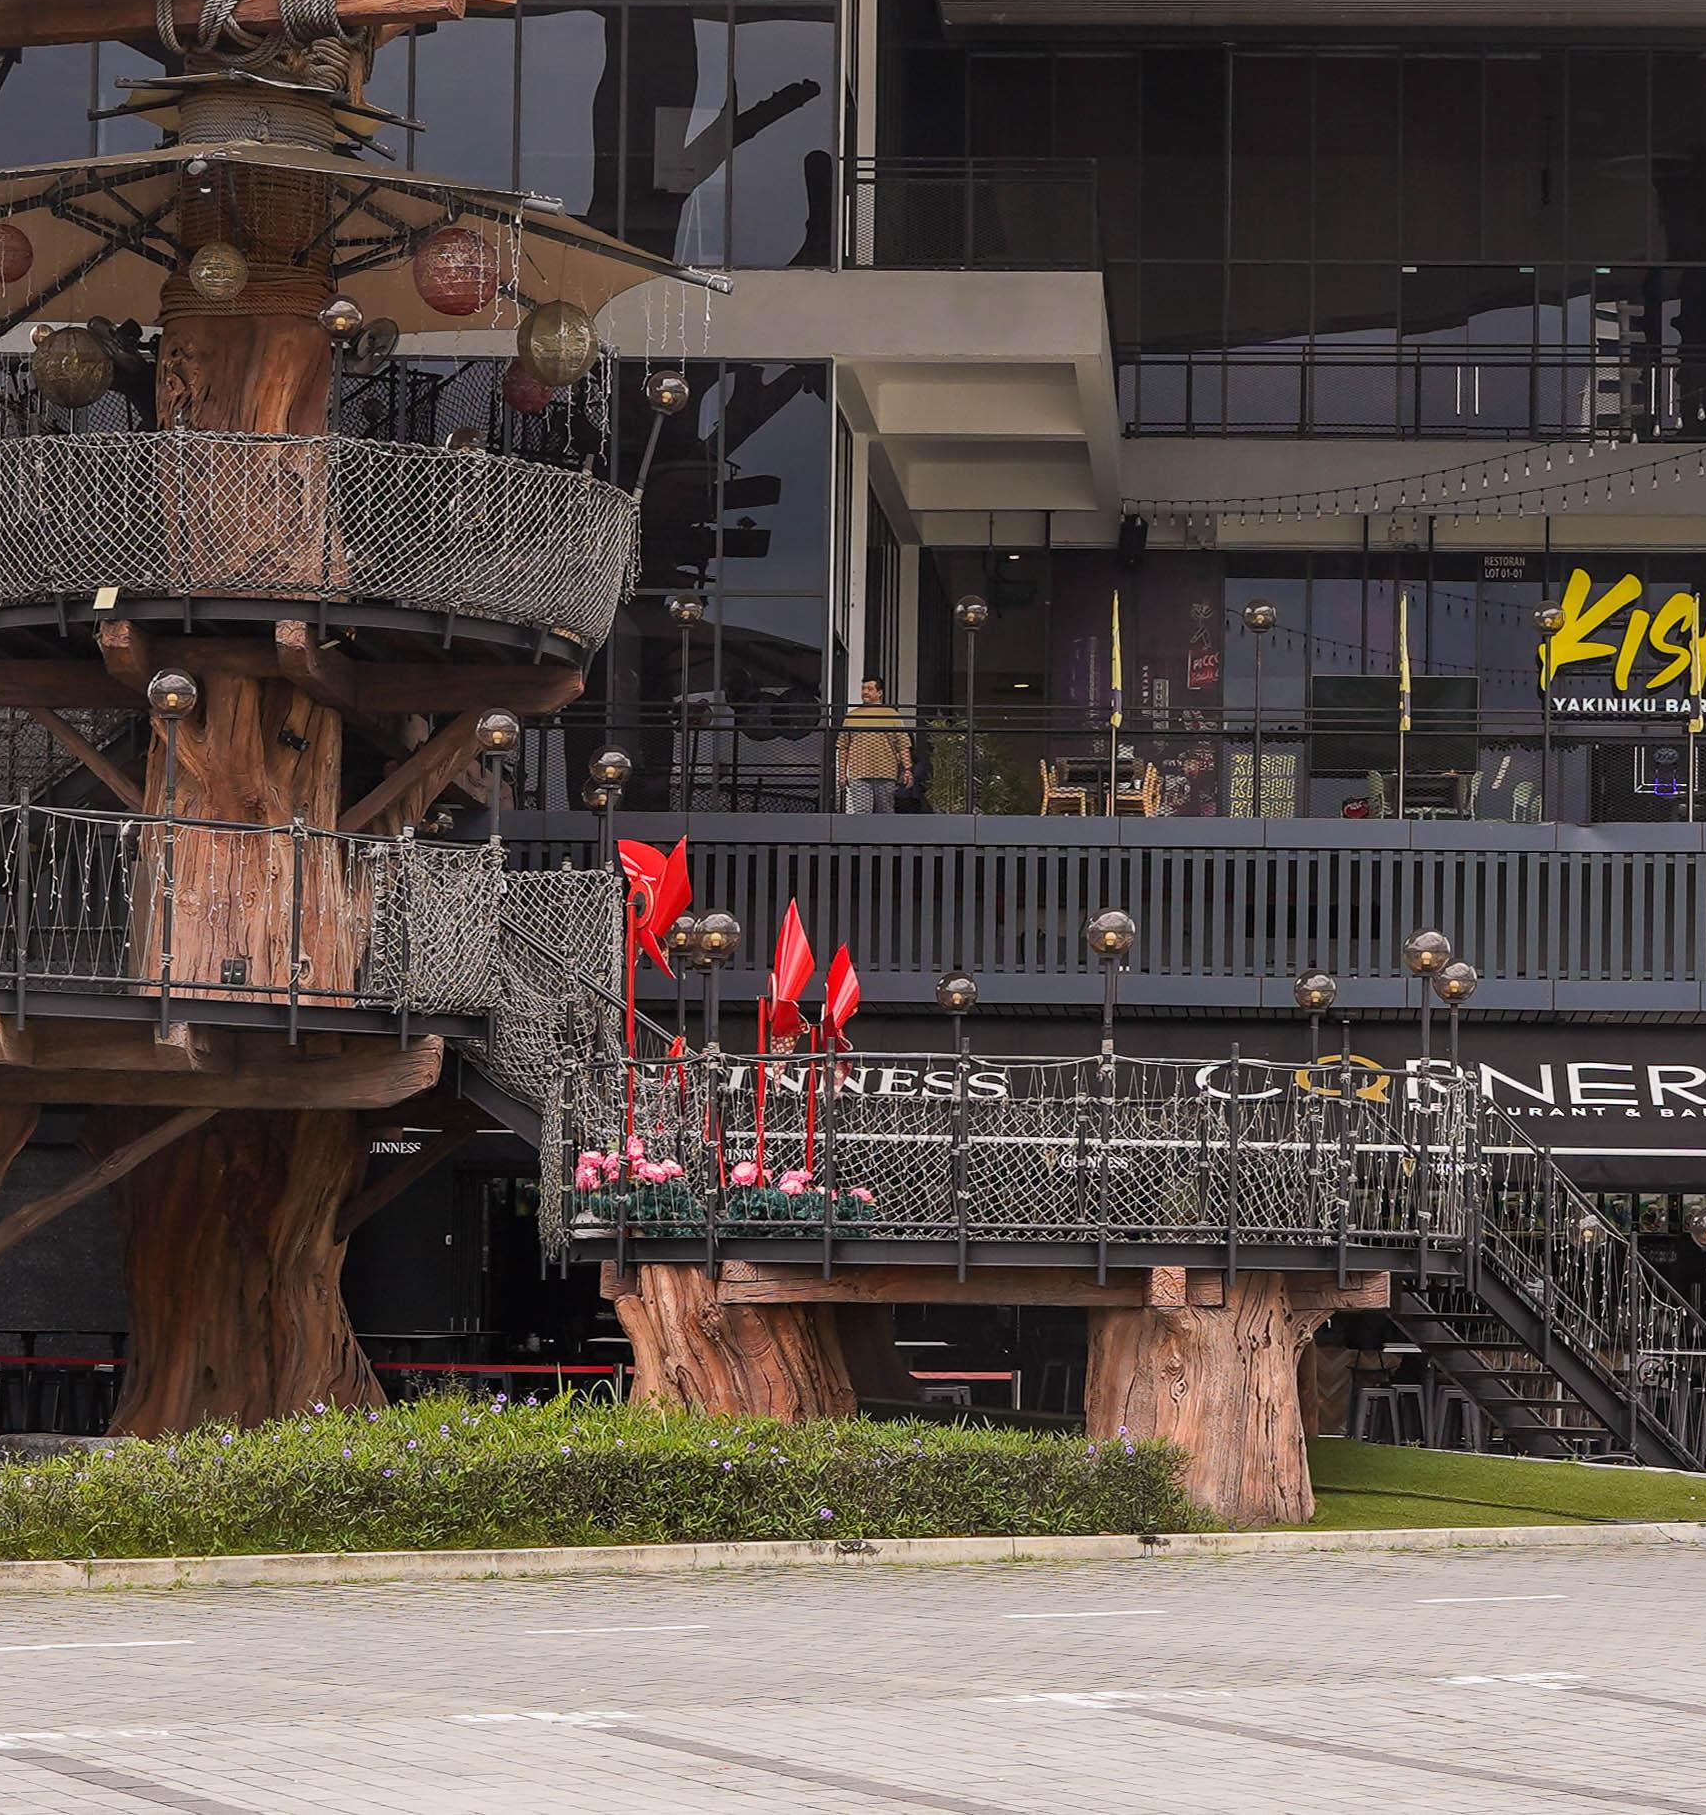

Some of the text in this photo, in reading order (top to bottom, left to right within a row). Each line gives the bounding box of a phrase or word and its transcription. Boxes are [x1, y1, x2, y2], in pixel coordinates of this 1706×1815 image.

[1483, 556, 1526, 566] RESTORAN
[1484, 568, 1499, 579] LOT
[1553, 697, 1657, 713] YAKINIKU
[726, 1066, 1010, 1099] INNESS
[1625, 1107, 1642, 1118] &
[369, 1141, 422, 1155] INNESS
